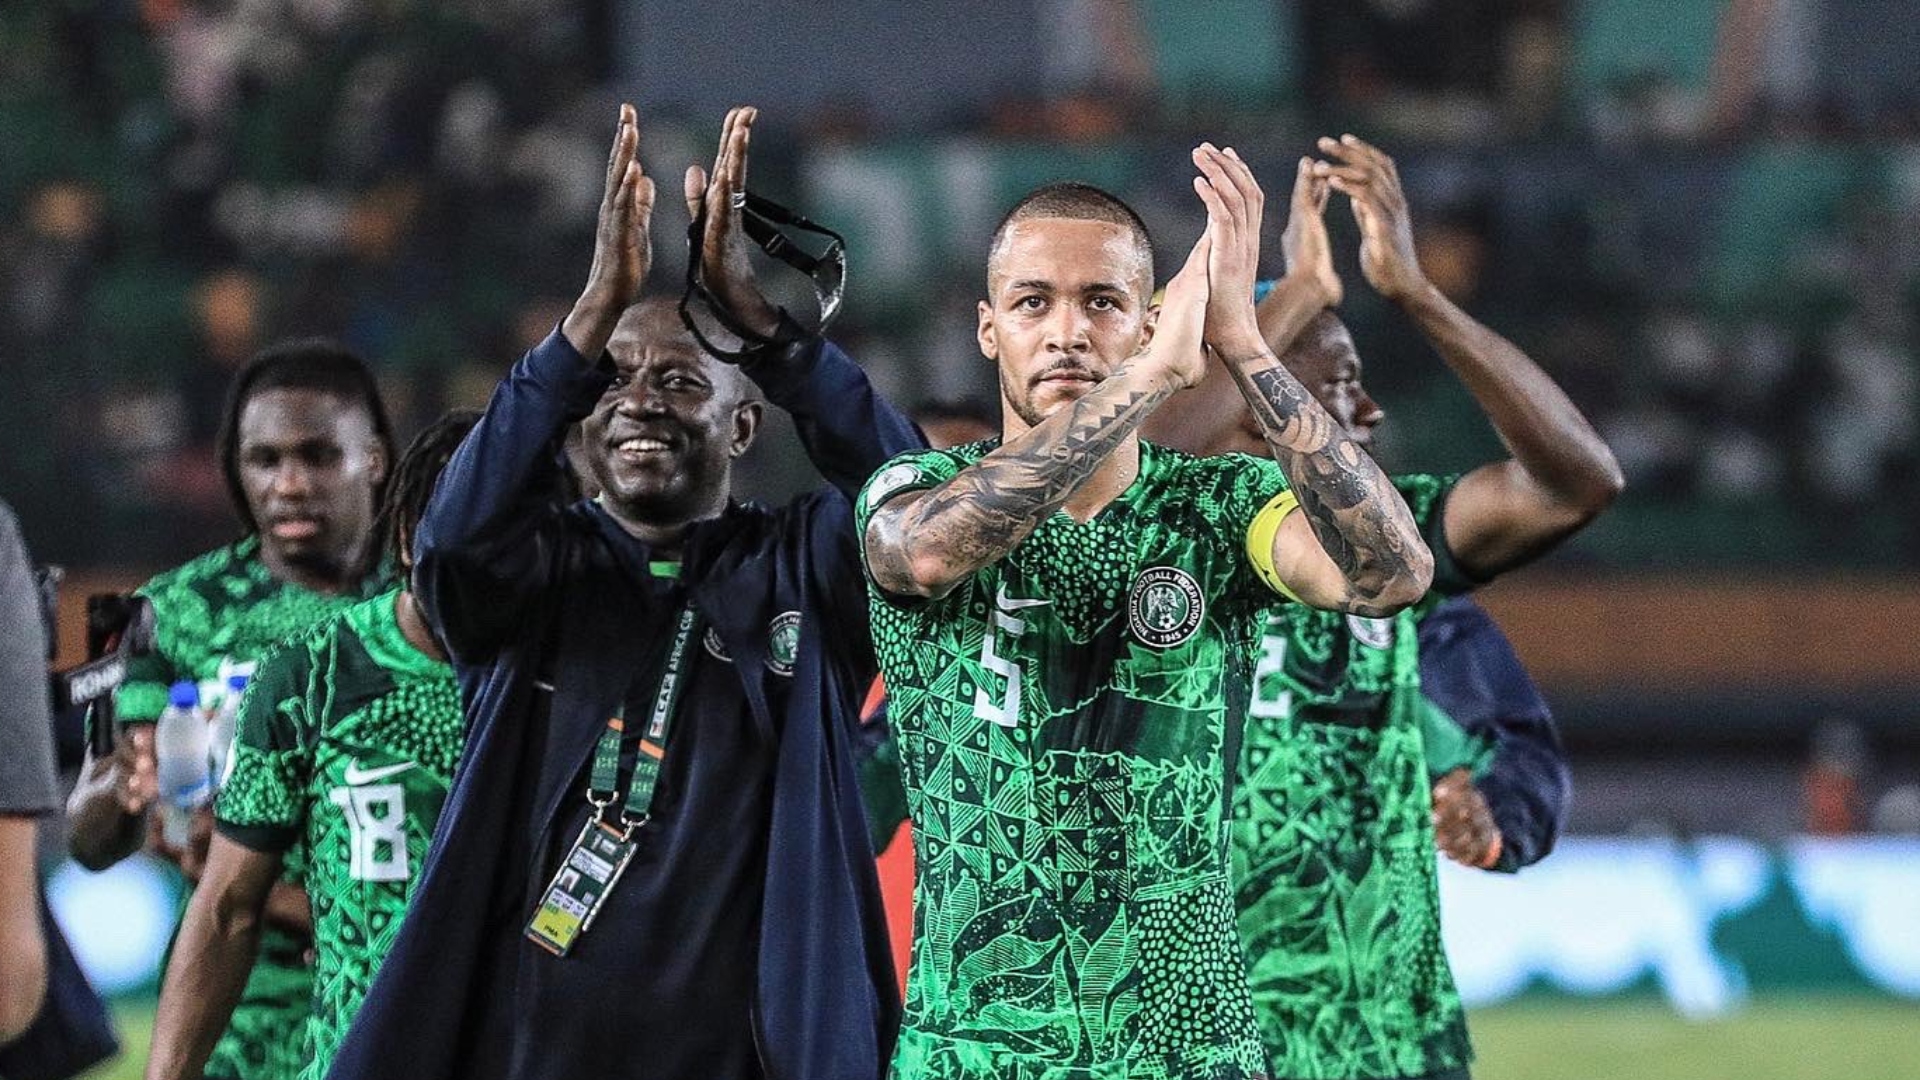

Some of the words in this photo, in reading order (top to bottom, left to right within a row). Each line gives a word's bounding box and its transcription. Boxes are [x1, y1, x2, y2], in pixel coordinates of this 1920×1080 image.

[1133, 571, 1172, 599] FOOTBALL
[1173, 573, 1201, 627] FEDERATION
[1131, 600, 1149, 637] NIGERIA
[1160, 632, 1182, 642] 1945
[668, 632, 688, 671] AFRICA
[974, 610, 1026, 728] 5
[329, 783, 409, 881] 18
